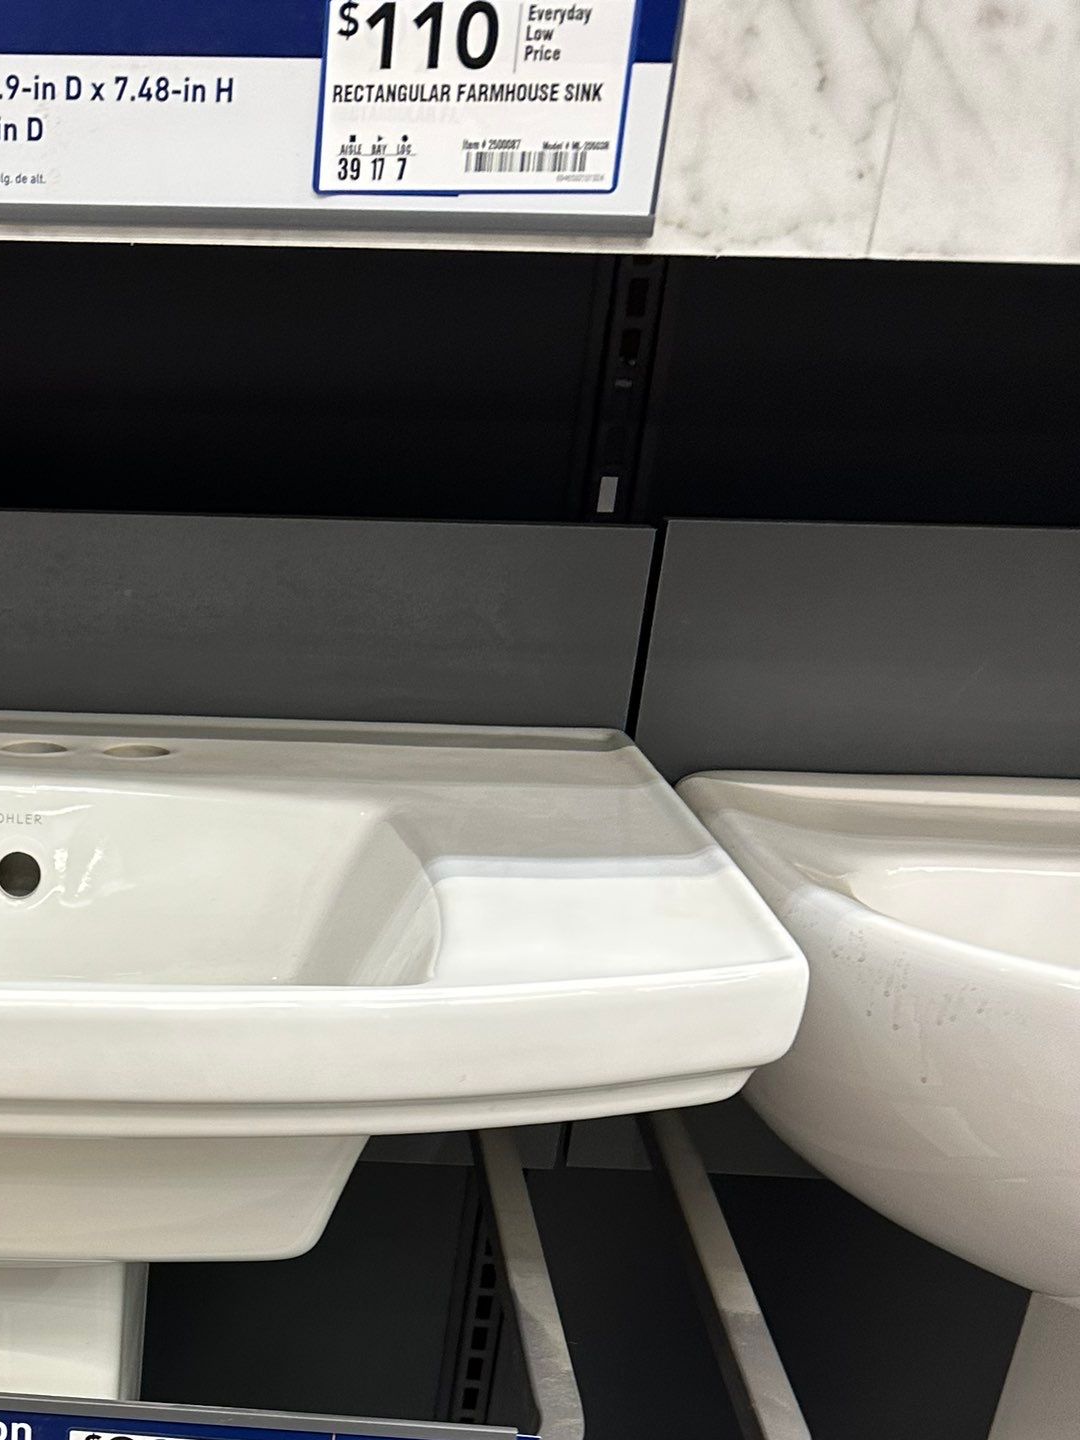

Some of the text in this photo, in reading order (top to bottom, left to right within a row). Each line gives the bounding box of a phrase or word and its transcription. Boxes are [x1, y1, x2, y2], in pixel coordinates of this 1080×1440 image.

[527, 4, 593, 25] Everyday
[337, 0, 499, 71] $110
[526, 26, 554, 41] Low
[524, 45, 561, 62] Price
[66, 76, 82, 101] D
[90, 82, 105, 101] x
[114, 76, 206, 102] 7.48-in
[215, 78, 234, 103] H
[332, 82, 604, 103] RECTANGULAR FARMHOUSE SINK
[27, 117, 43, 141] D
[15, 174, 28, 184] de
[30, 174, 46, 184] alt.
[337, 157, 407, 181] 39 17 7
